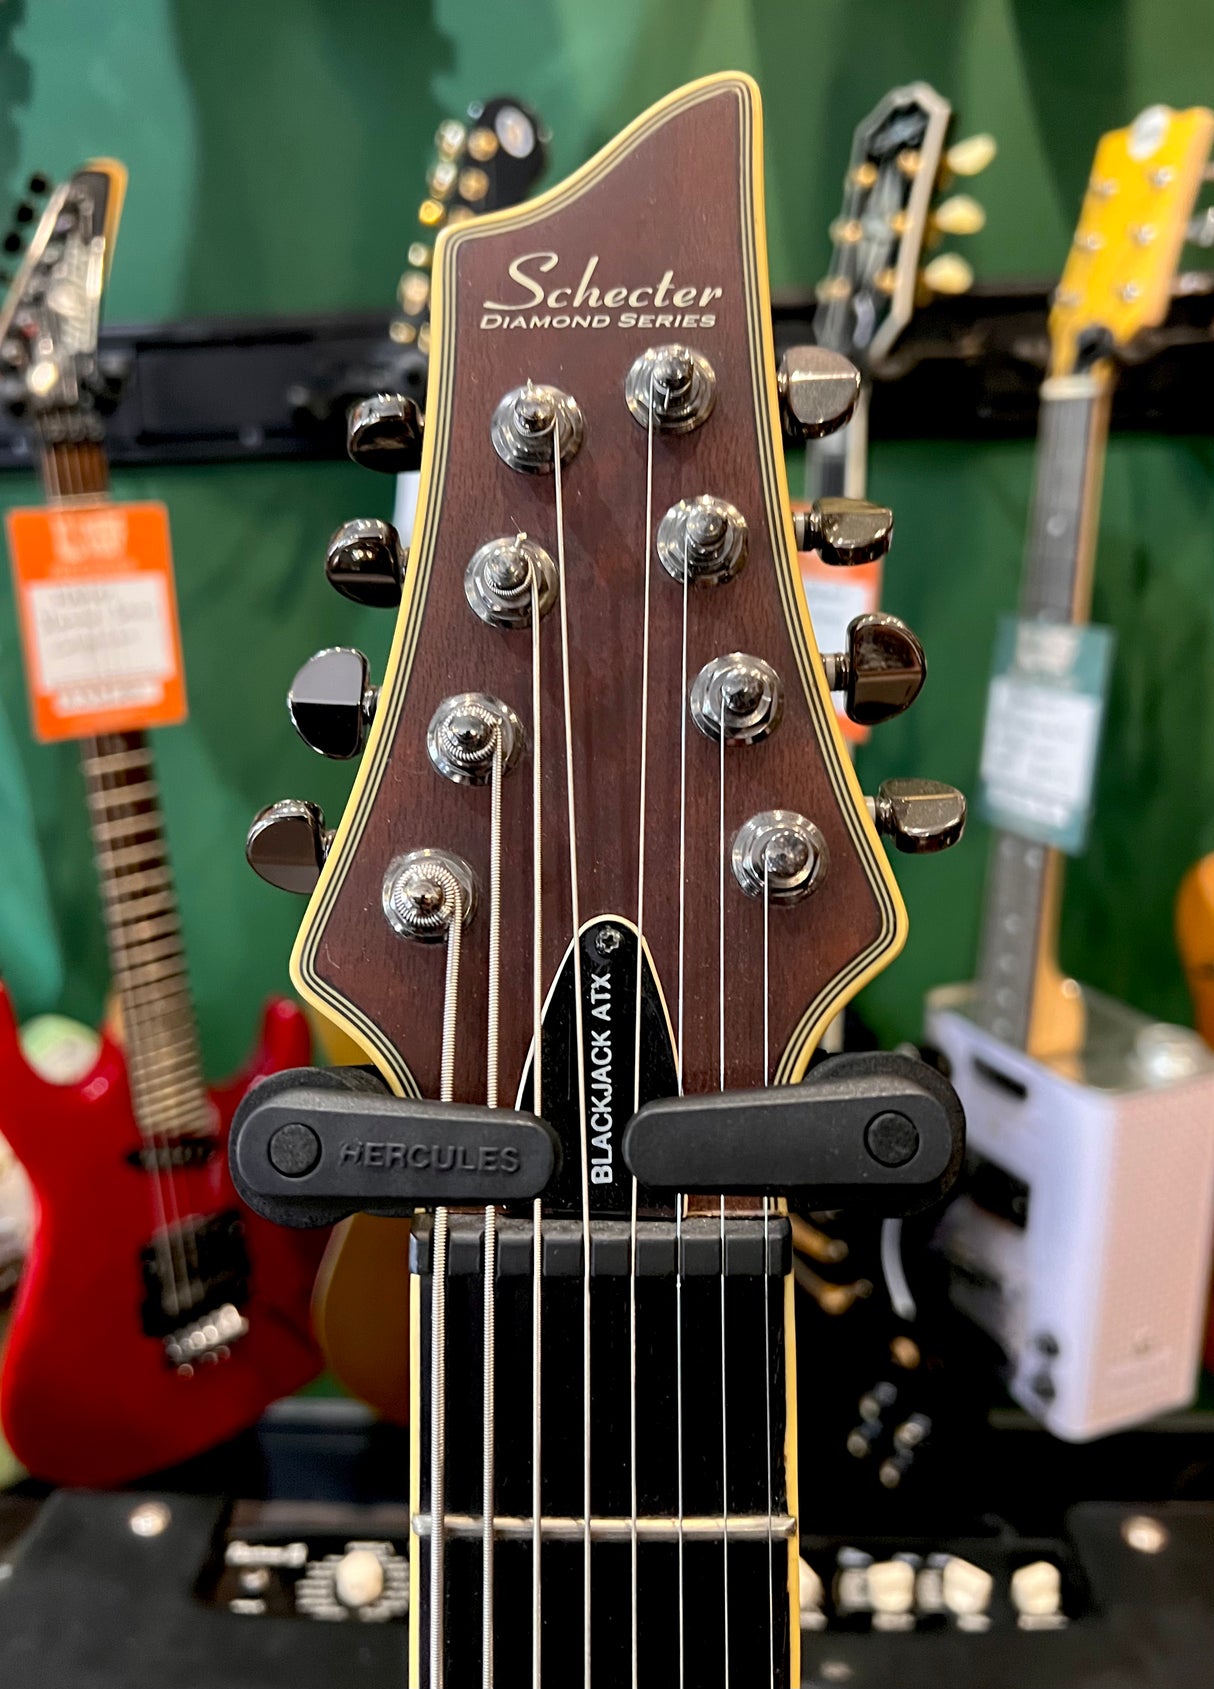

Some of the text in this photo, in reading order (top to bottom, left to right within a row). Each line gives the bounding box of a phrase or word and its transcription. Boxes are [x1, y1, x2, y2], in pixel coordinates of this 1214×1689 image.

[483, 252, 723, 311] Schecter
[480, 313, 716, 330] DIAMOND SERIES
[590, 973, 613, 1185] BLACKJACK ATX
[338, 1140, 522, 1174] HERCULES
